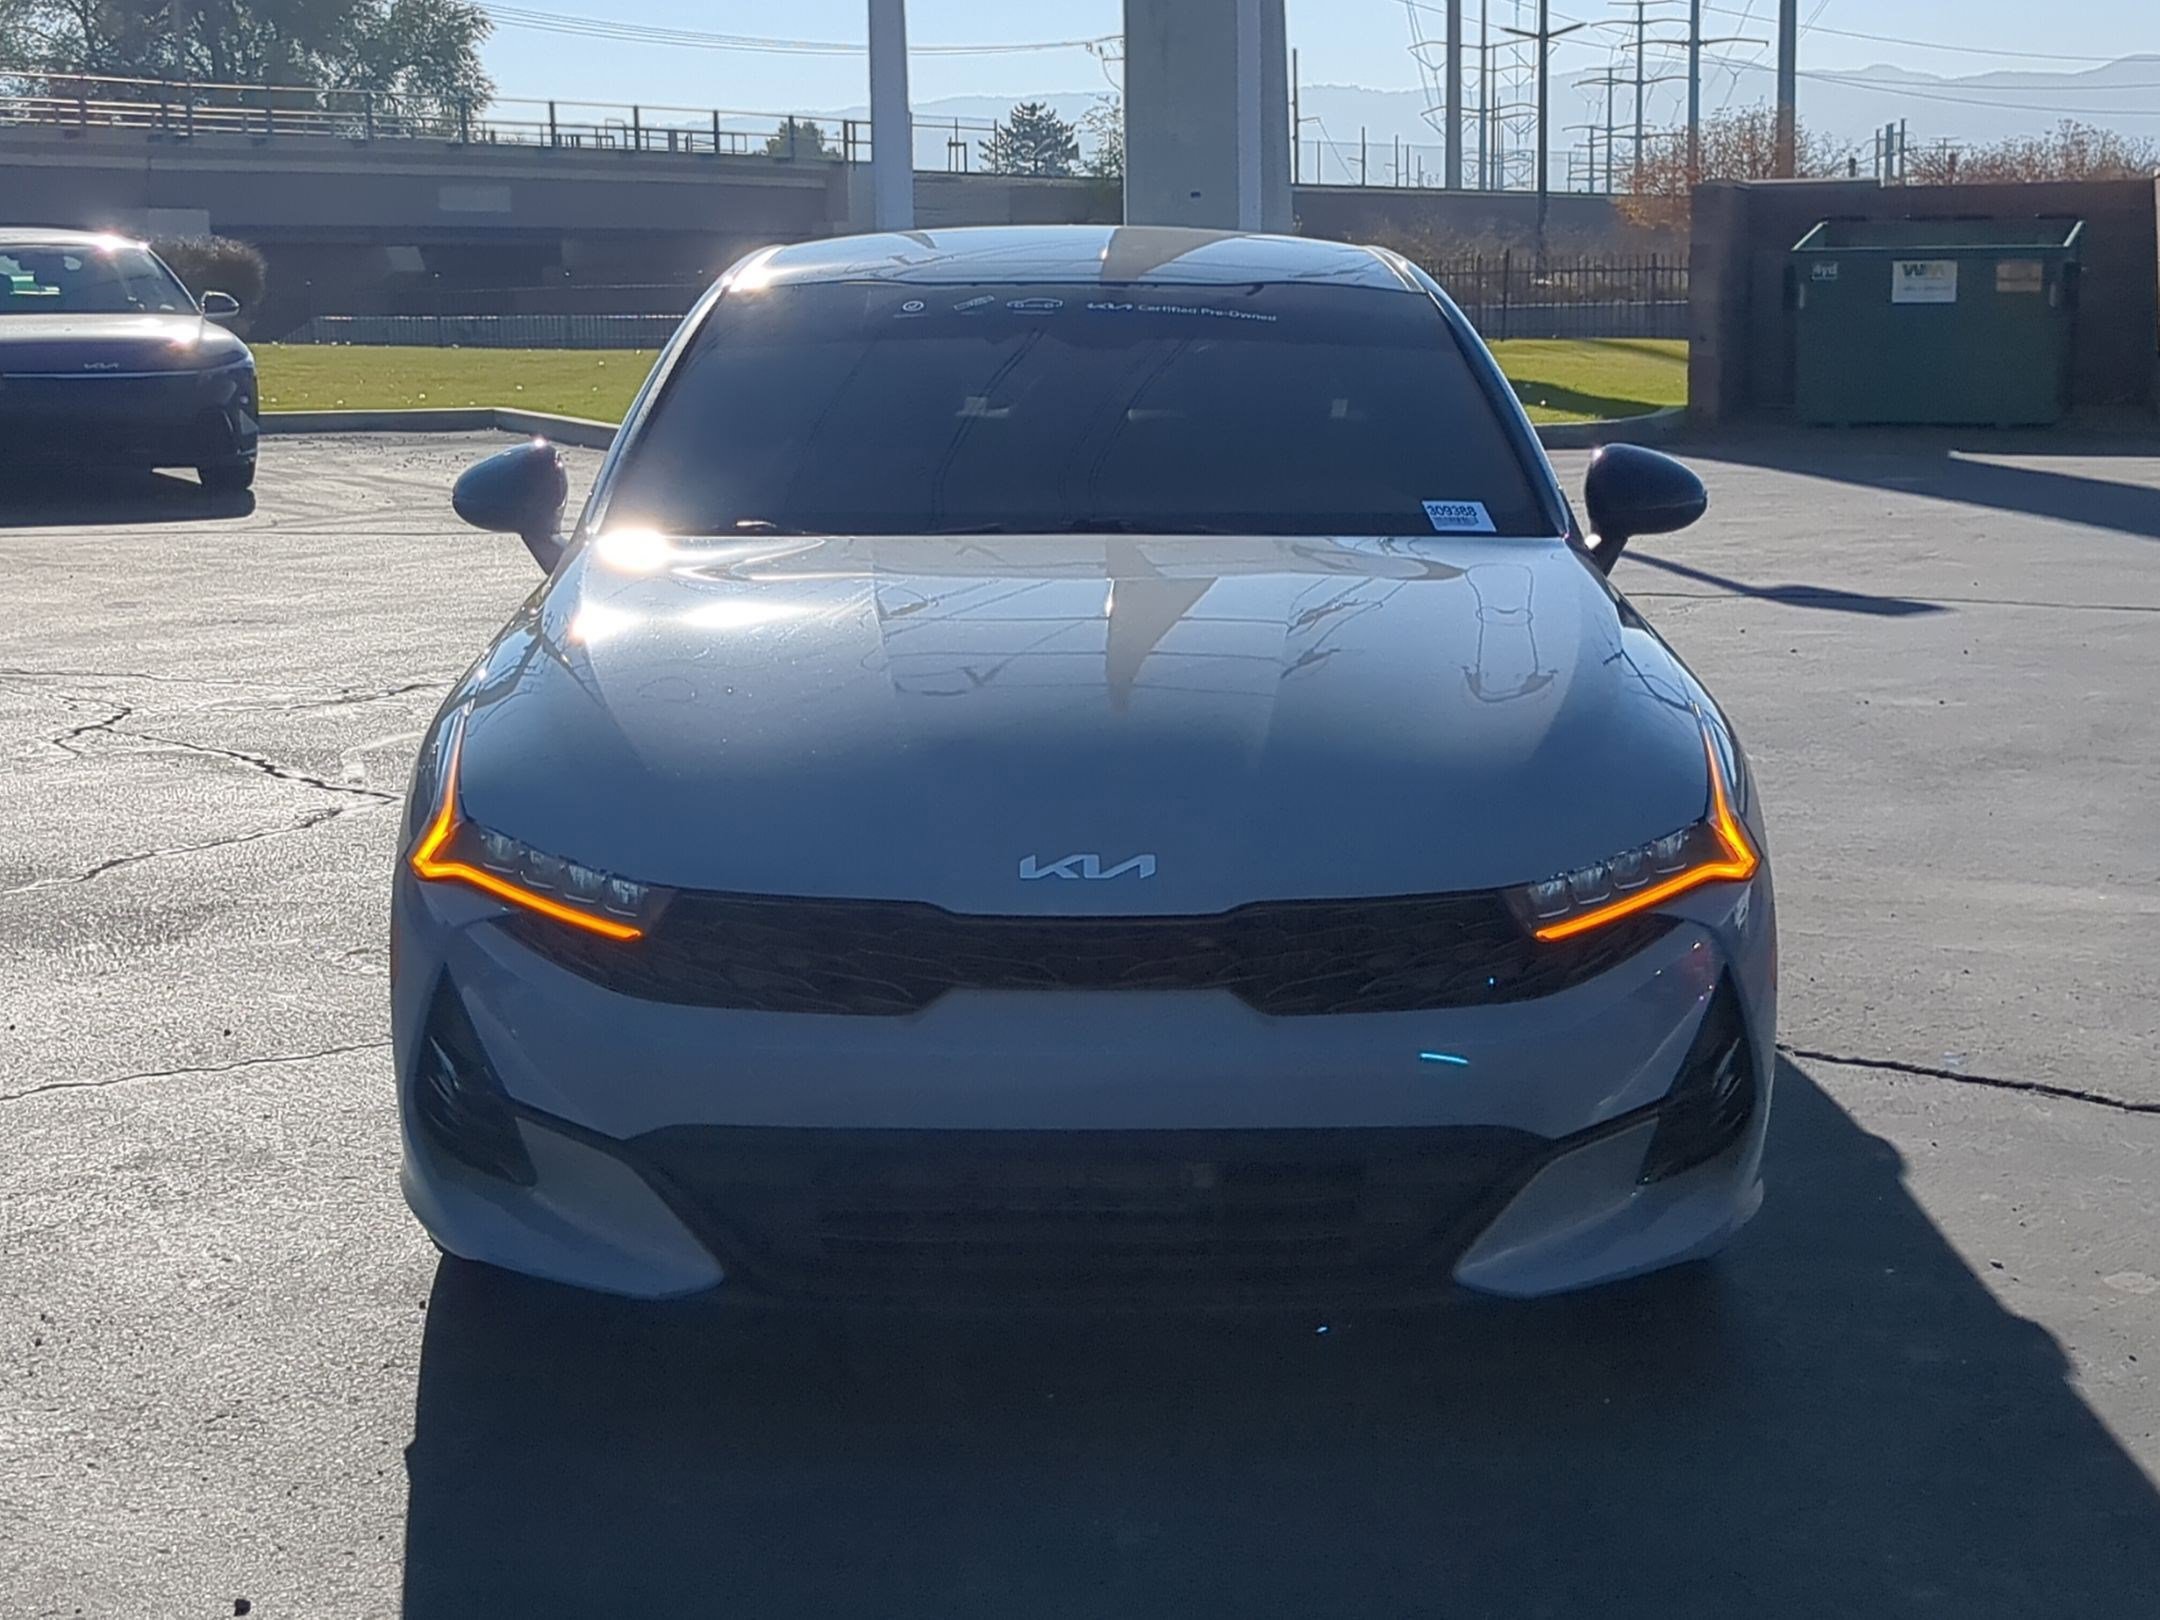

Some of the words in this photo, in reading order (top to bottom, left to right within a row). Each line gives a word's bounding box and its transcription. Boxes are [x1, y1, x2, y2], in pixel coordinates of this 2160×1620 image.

[1138, 303, 1197, 315] Certified
[1200, 308, 1277, 322] Pre-Owned
[1426, 505, 1478, 517] 309388
[1019, 854, 1156, 879] KIA
